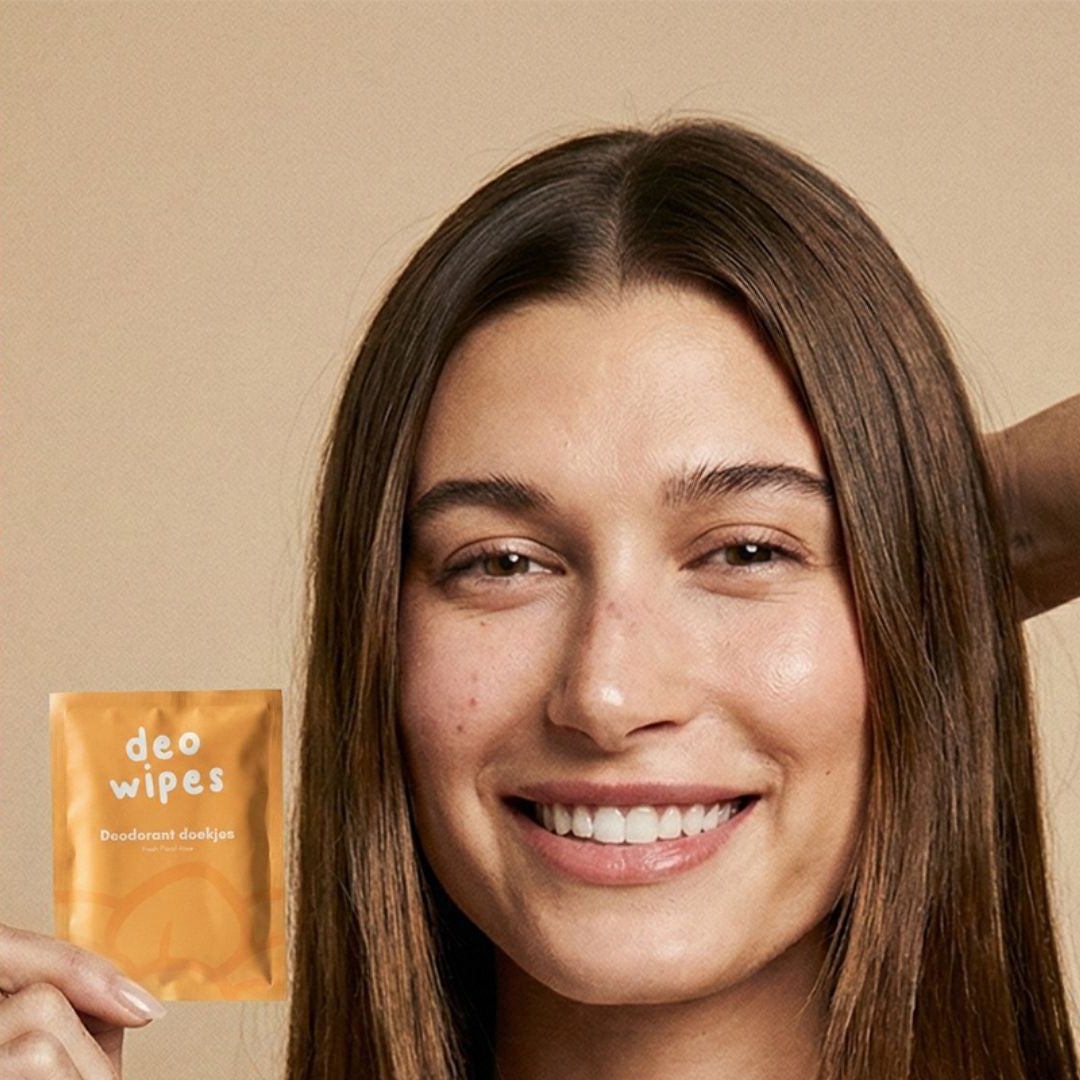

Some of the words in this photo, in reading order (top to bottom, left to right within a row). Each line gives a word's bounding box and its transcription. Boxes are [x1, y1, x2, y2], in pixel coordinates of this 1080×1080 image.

[125, 726, 201, 762] deo
[109, 763, 224, 804] wipes
[100, 828, 176, 842] Deodorant
